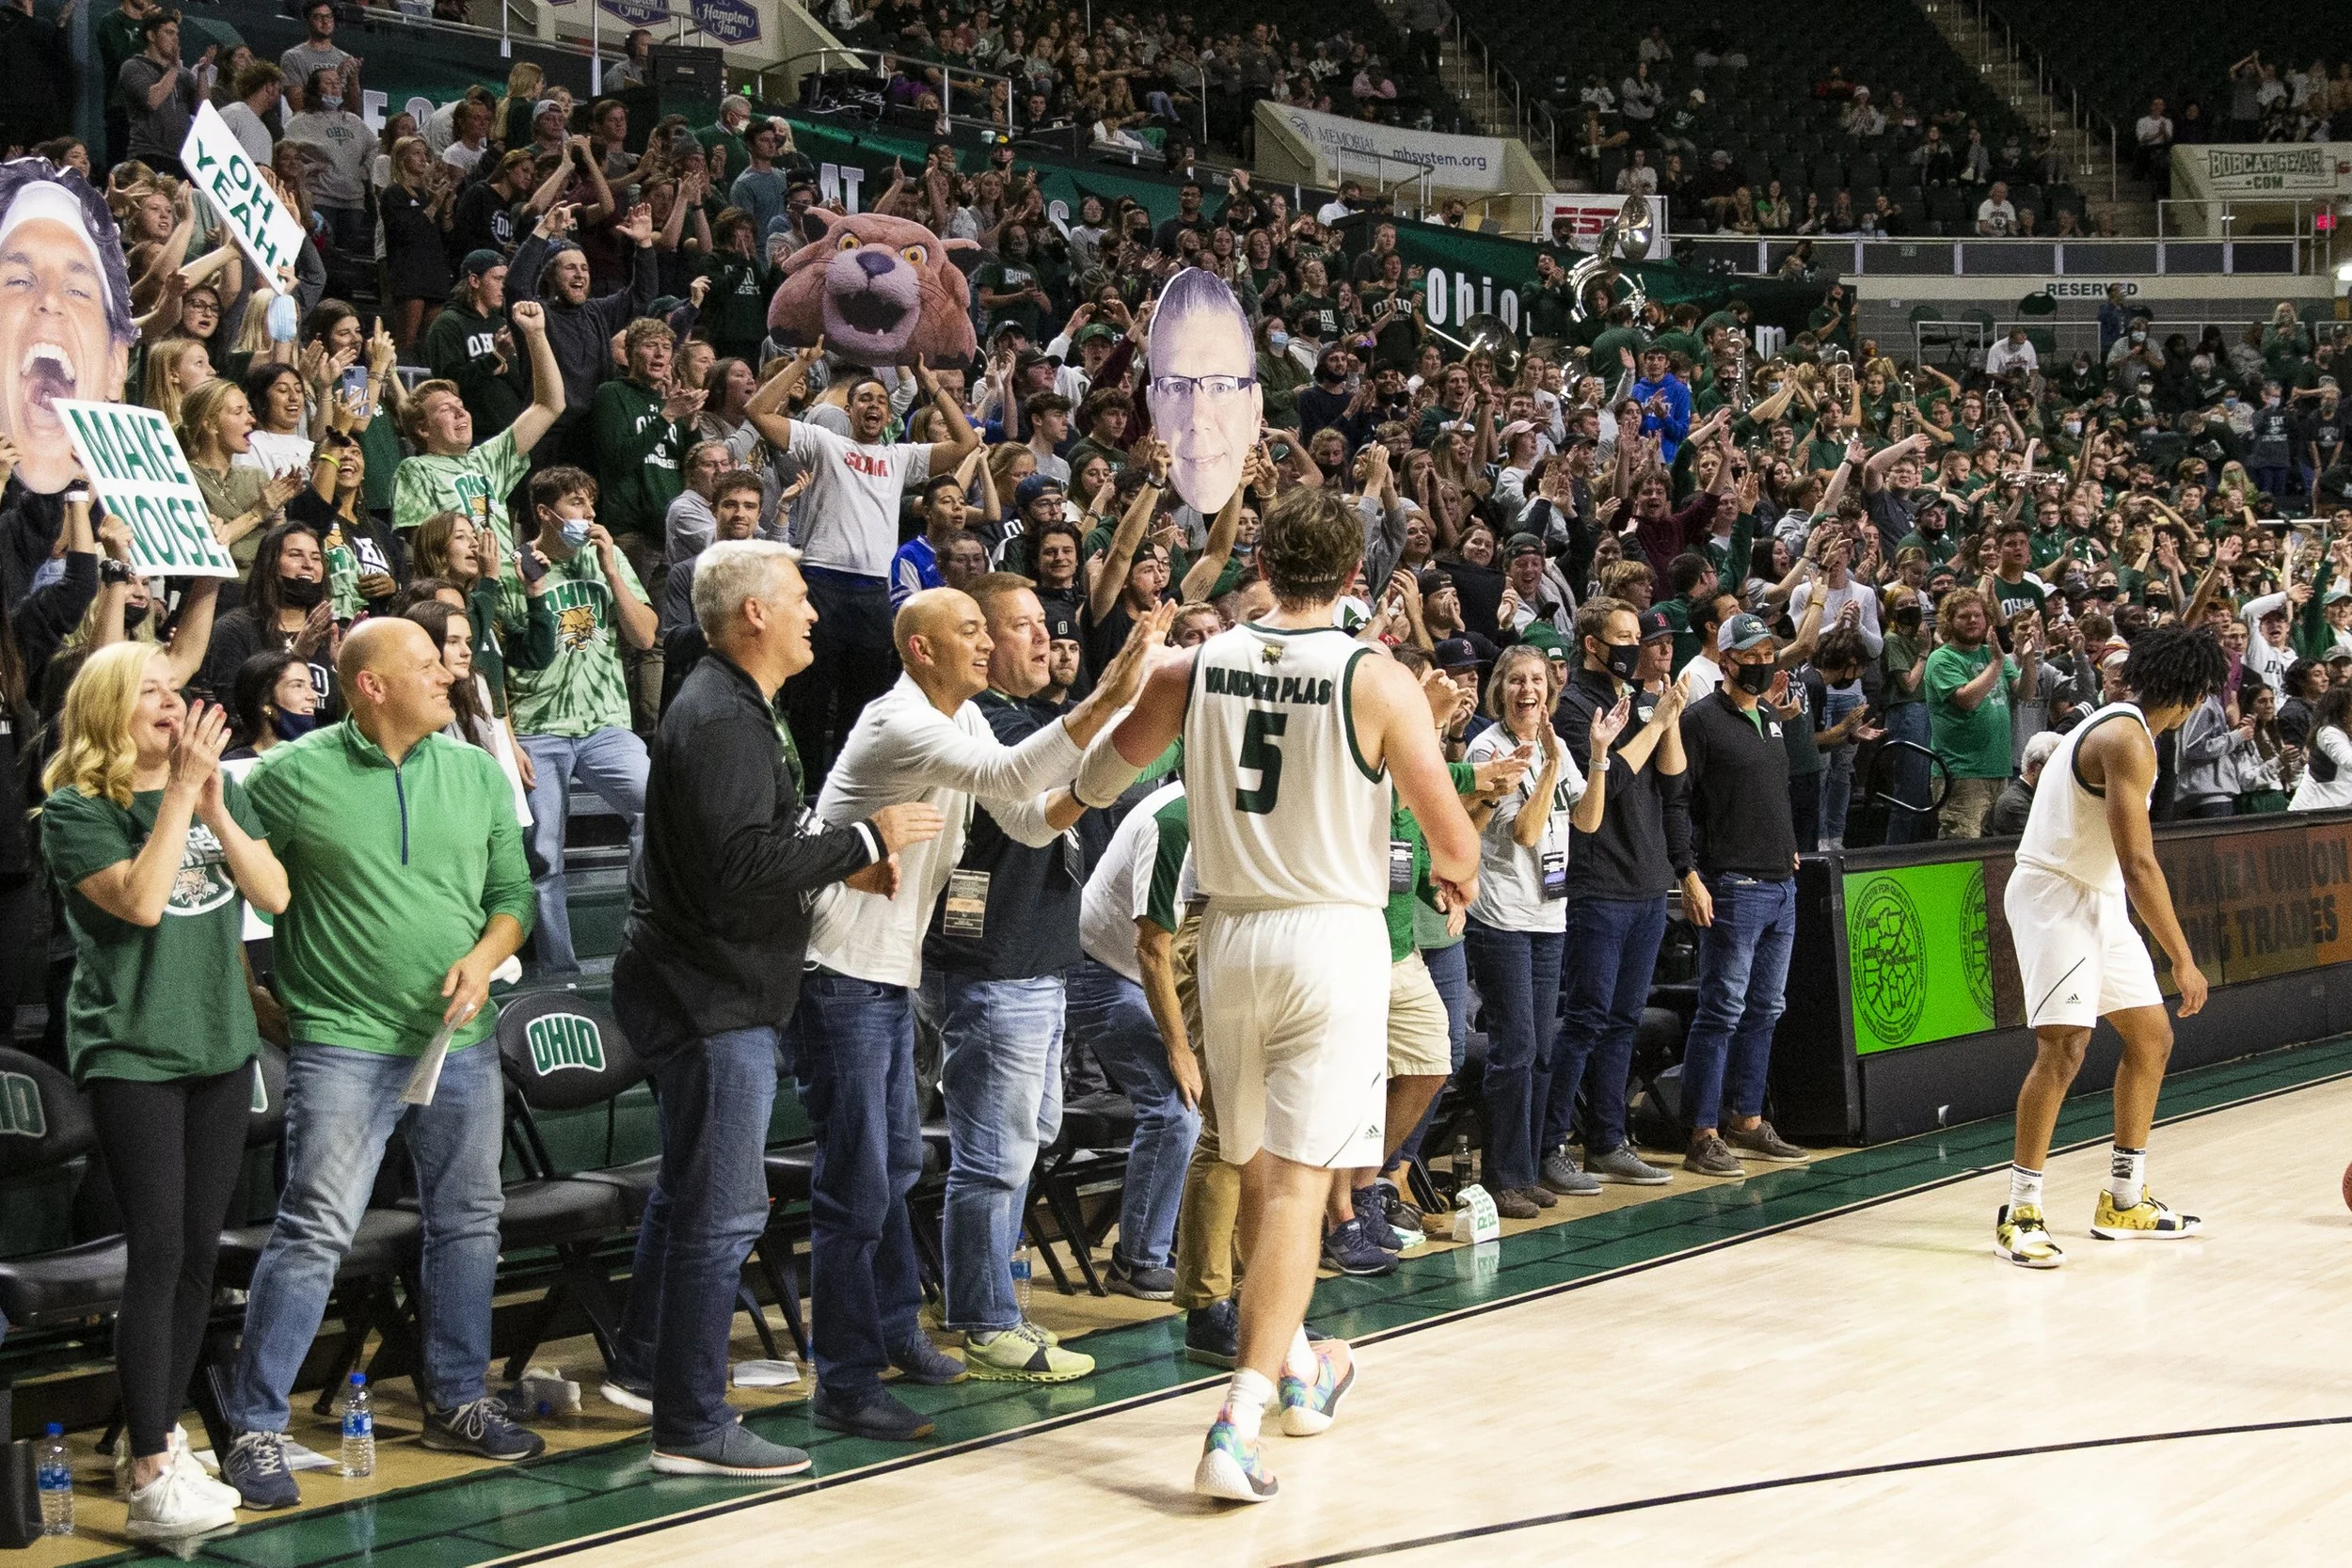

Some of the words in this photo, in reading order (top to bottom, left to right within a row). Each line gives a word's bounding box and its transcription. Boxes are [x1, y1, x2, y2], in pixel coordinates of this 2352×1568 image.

[697, 3, 754, 28] Hampton
[712, 19, 741, 39] Inn
[326, 126, 355, 139] OHIO
[1318, 127, 1378, 153] MEMORIAL
[1393, 146, 1487, 170] mhsystem.org
[2209, 151, 2274, 177] BOBCAT
[230, 154, 275, 224] OH
[1426, 267, 1518, 334] Ohio
[2045, 282, 2138, 296] RESERVD
[69, 408, 190, 485] MAKE
[103, 495, 231, 568] NOISE!
[1205, 666, 1279, 703] VANDER
[1279, 676, 1332, 705] PLAS
[1235, 708, 1289, 816] 5
[2265, 837, 2349, 892] UNION
[2235, 894, 2339, 958] TRADES
[525, 1011, 607, 1076] OHIO
